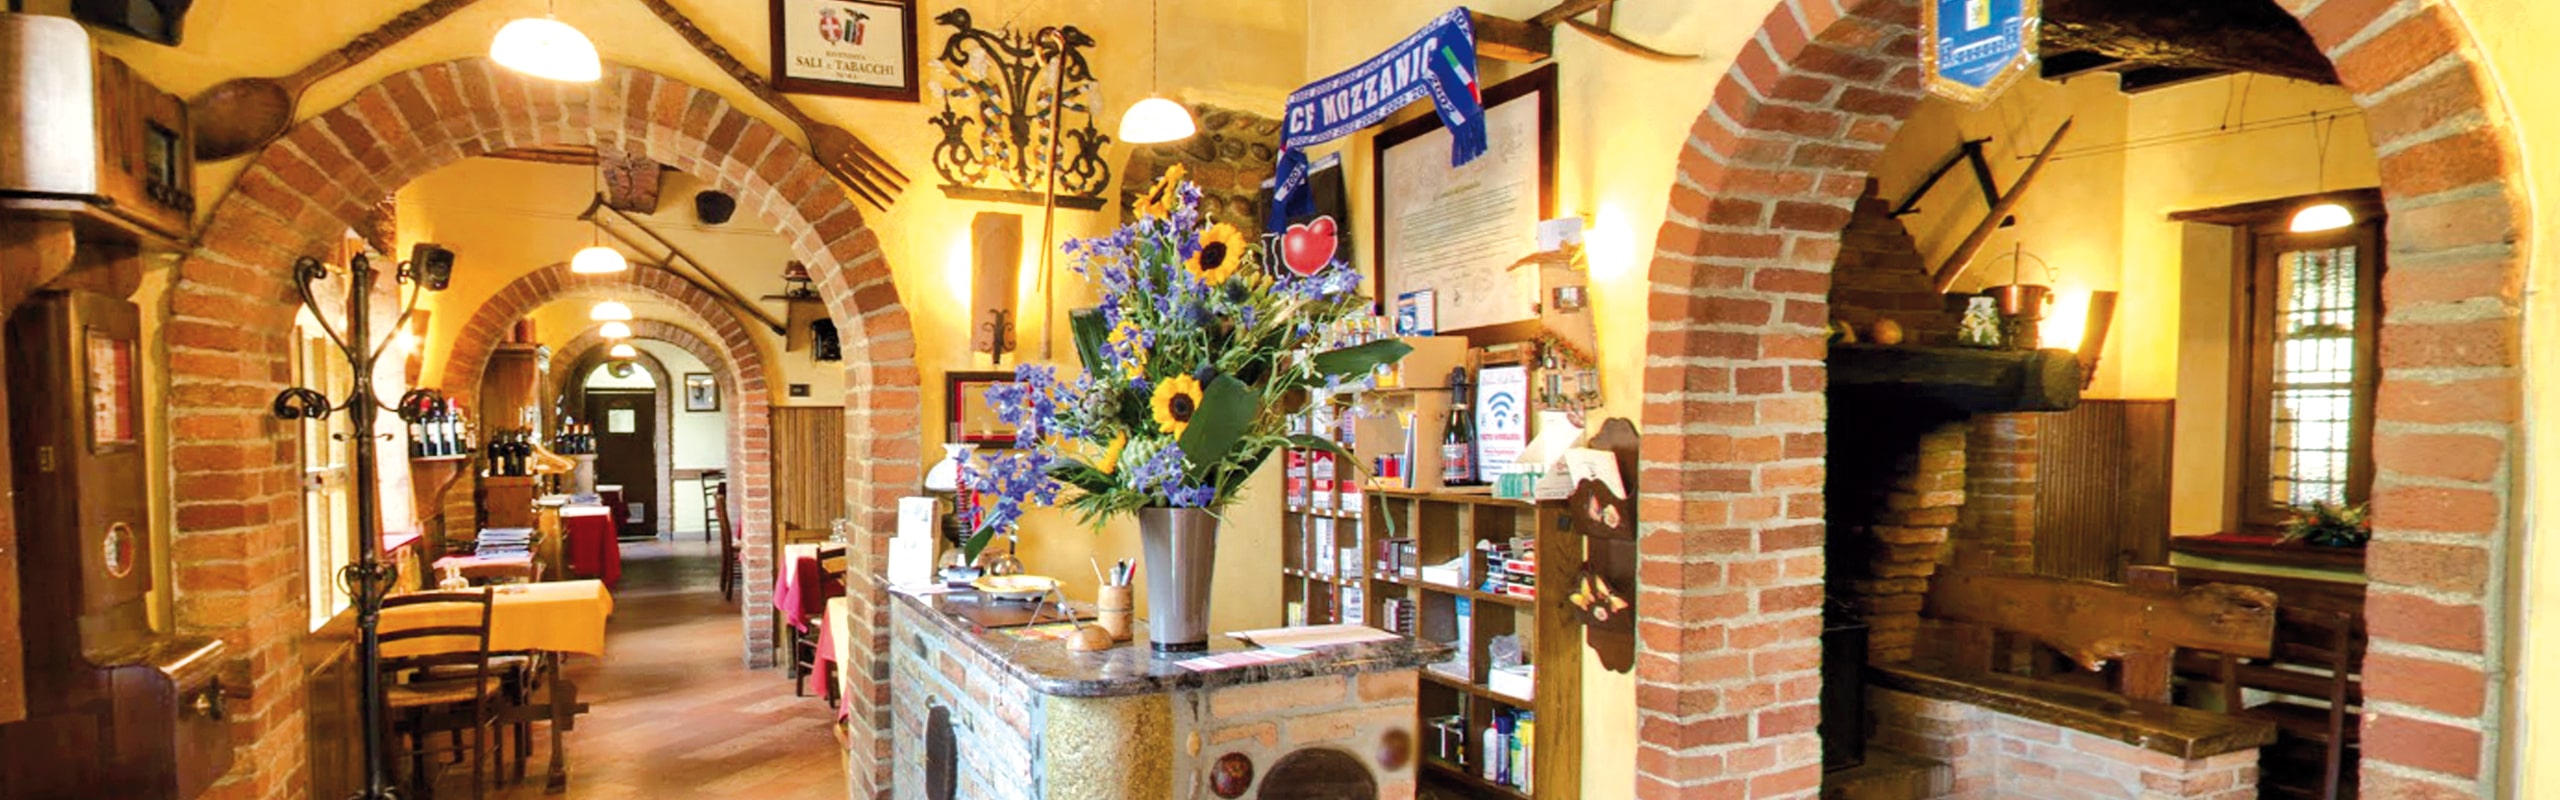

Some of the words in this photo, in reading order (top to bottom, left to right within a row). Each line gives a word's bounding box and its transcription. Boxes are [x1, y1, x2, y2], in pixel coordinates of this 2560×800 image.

[796, 57, 823, 69] SALI
[835, 59, 894, 76] TABACCHI
[1289, 102, 1316, 134] CF
